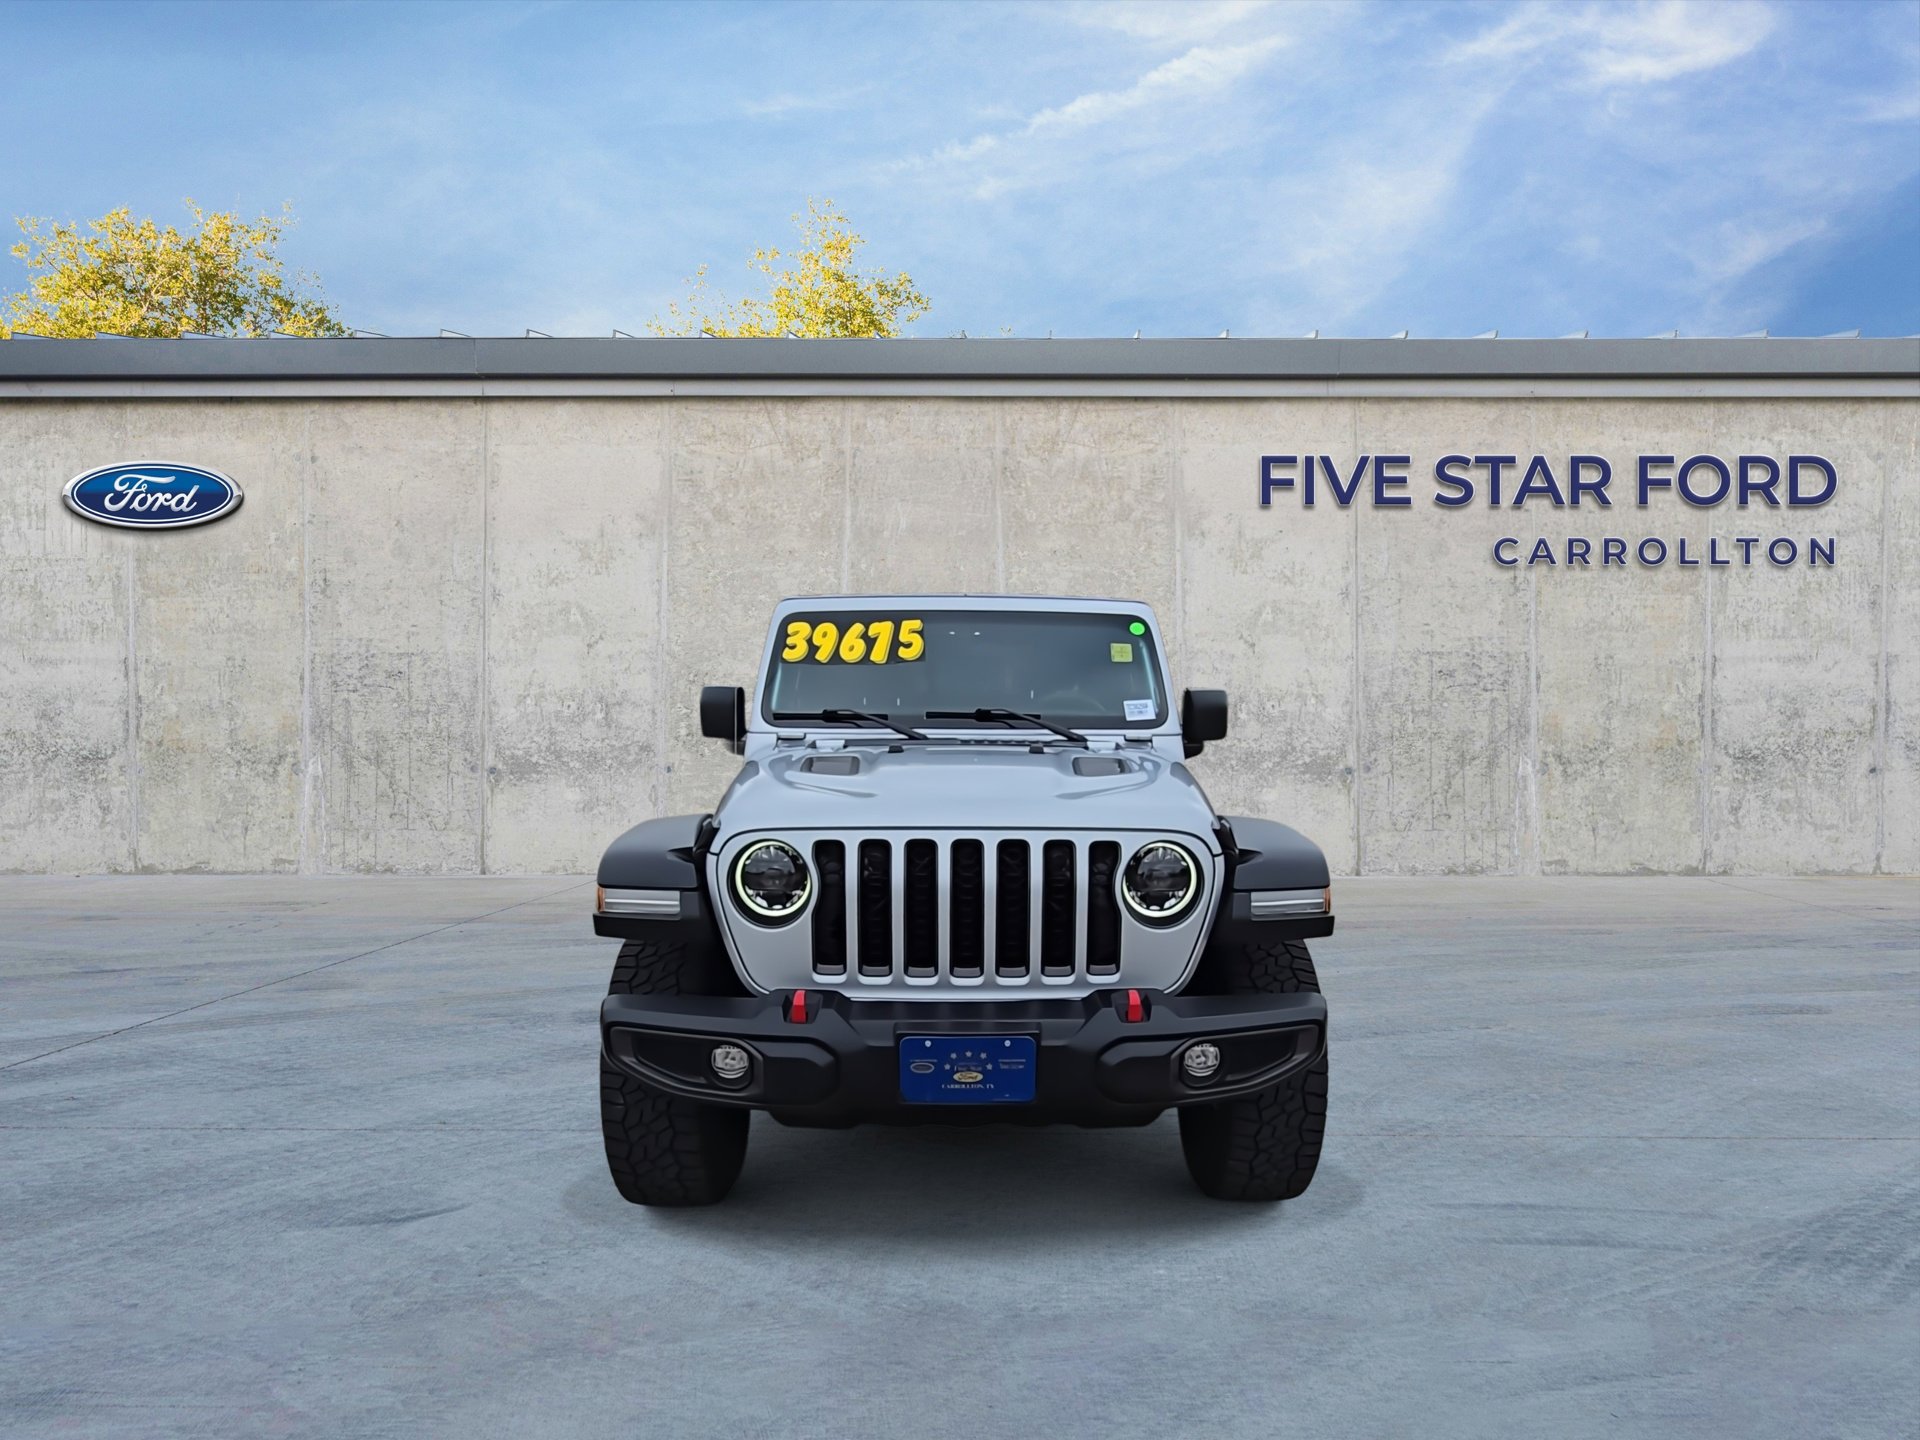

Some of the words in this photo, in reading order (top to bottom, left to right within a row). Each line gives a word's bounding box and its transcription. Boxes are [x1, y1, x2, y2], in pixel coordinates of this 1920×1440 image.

[104, 474, 200, 512] Ford
[1260, 455, 1412, 505] FIVE
[1434, 455, 1613, 505] STAR
[1637, 455, 1838, 505] FORD
[1493, 537, 1836, 565] CARROLLTON
[782, 619, 925, 664] 39675
